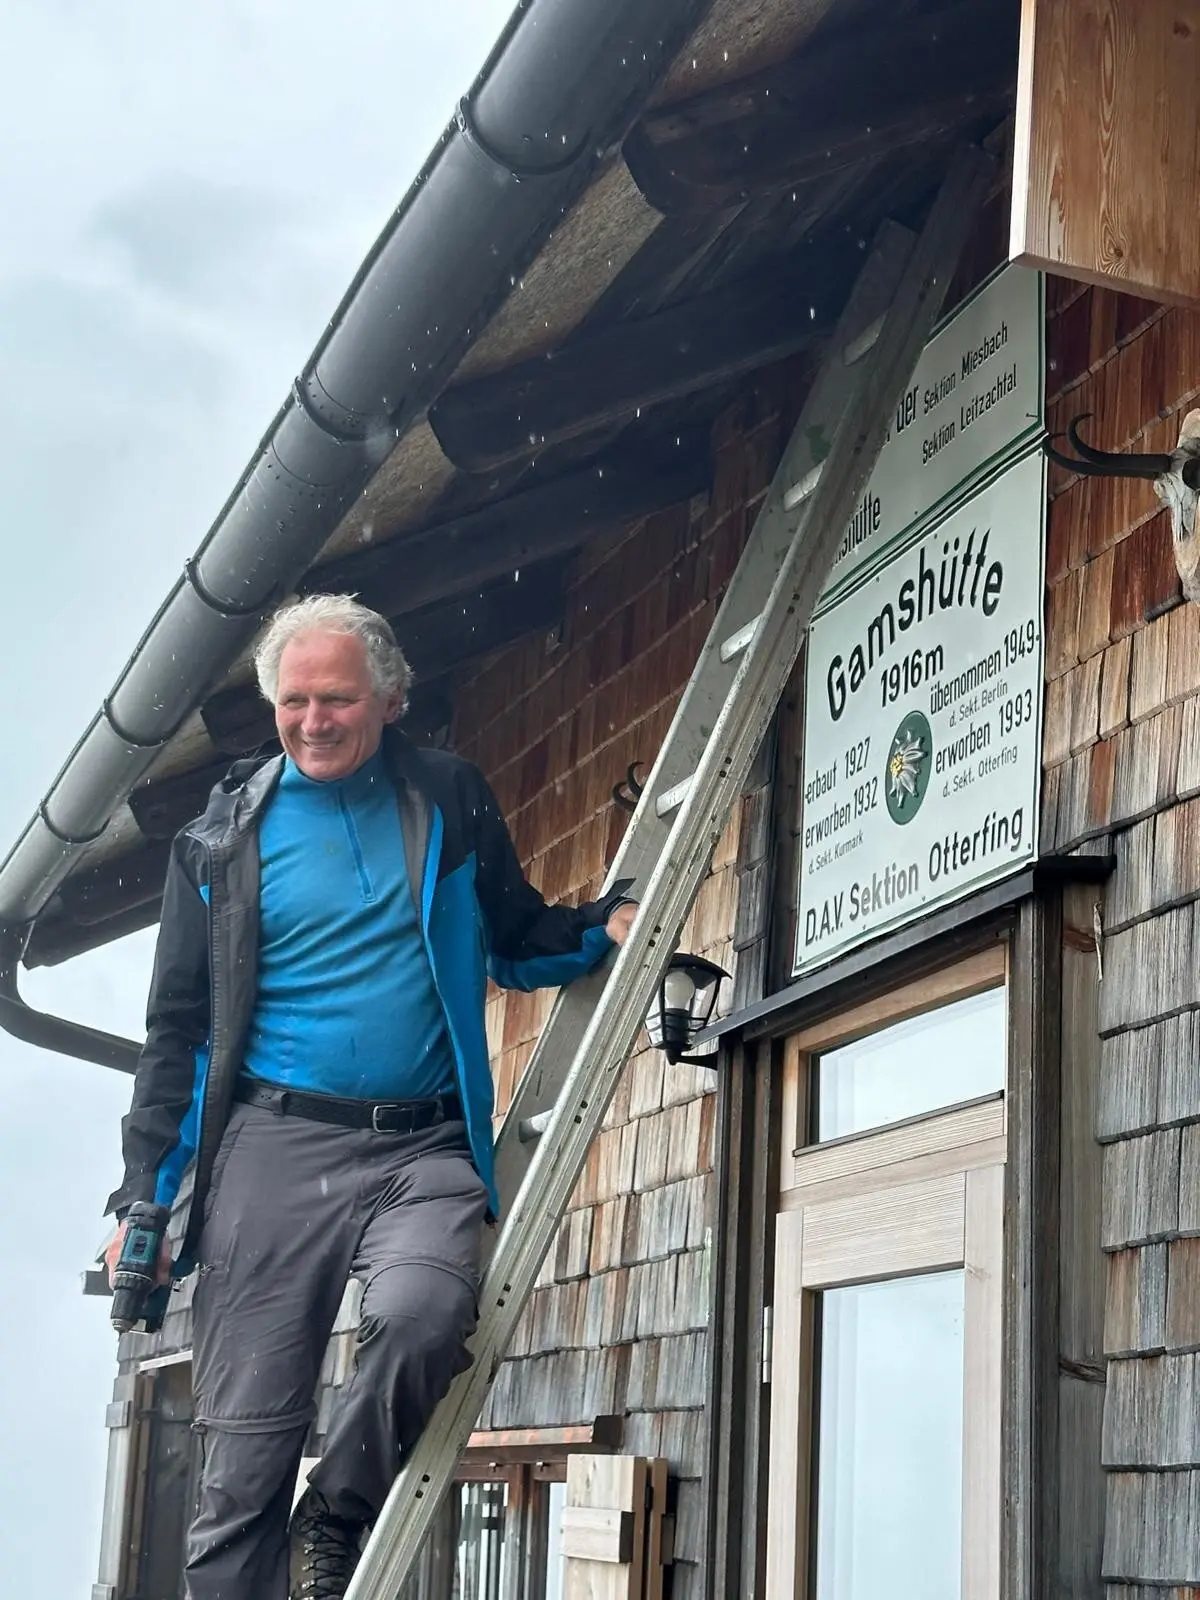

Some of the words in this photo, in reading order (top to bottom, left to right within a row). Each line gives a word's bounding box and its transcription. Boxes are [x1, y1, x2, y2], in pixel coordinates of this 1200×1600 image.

[923, 372, 956, 414] Sektion
[961, 321, 1008, 380] Miesbach
[922, 421, 956, 464] Sektion
[960, 364, 1017, 431] Leitzachtal
[826, 527, 1003, 722] Gamshütte
[881, 644, 944, 708] 1916m
[930, 649, 1001, 715] übernommen
[981, 679, 1008, 708] Berlin
[935, 721, 991, 775] erworben
[999, 688, 1032, 737] 1993
[806, 758, 838, 805] erbaut
[845, 735, 871, 779] 1927
[953, 766, 975, 793] Sekt.
[978, 745, 1018, 778] Otterfing
[805, 802, 851, 849] erworben
[854, 776, 879, 819] 1932
[834, 828, 864, 860] Kurmark
[850, 861, 920, 922] Sektion
[928, 807, 1024, 883] Otterfing
